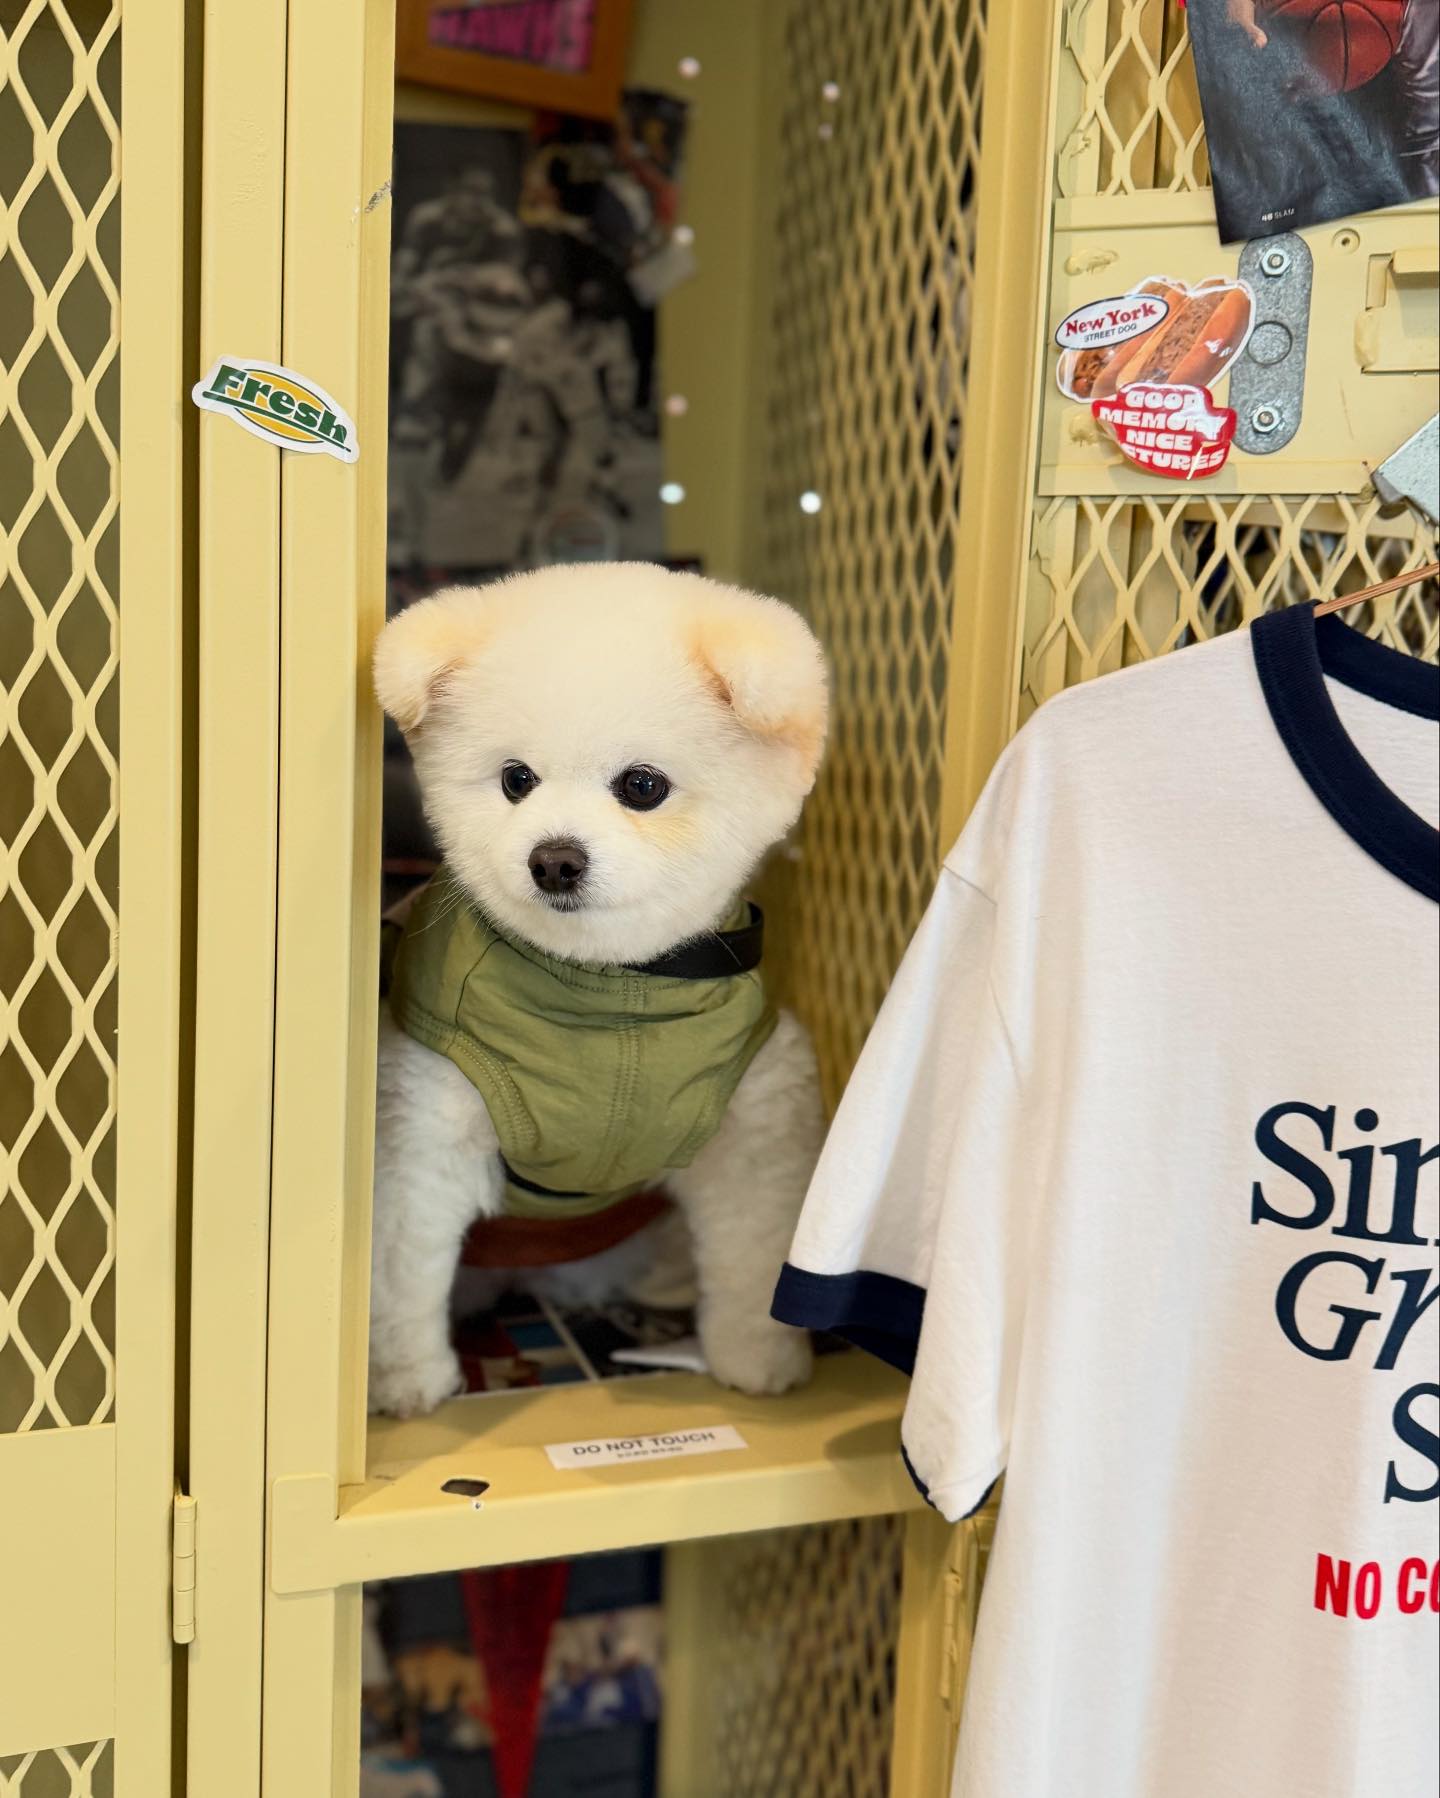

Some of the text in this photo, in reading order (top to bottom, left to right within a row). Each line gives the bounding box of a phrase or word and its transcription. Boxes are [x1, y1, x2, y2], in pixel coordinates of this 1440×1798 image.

[1275, 208, 1295, 219] SLAM
[1065, 303, 1157, 337] New York
[1084, 323, 1137, 342] STREET DOG
[210, 364, 347, 443] Fresh
[1125, 391, 1202, 410] GOOD
[1126, 430, 1193, 450] NICE
[573, 1432, 715, 1455] DO NOT TOUCH
[1314, 1552, 1381, 1620] NO
